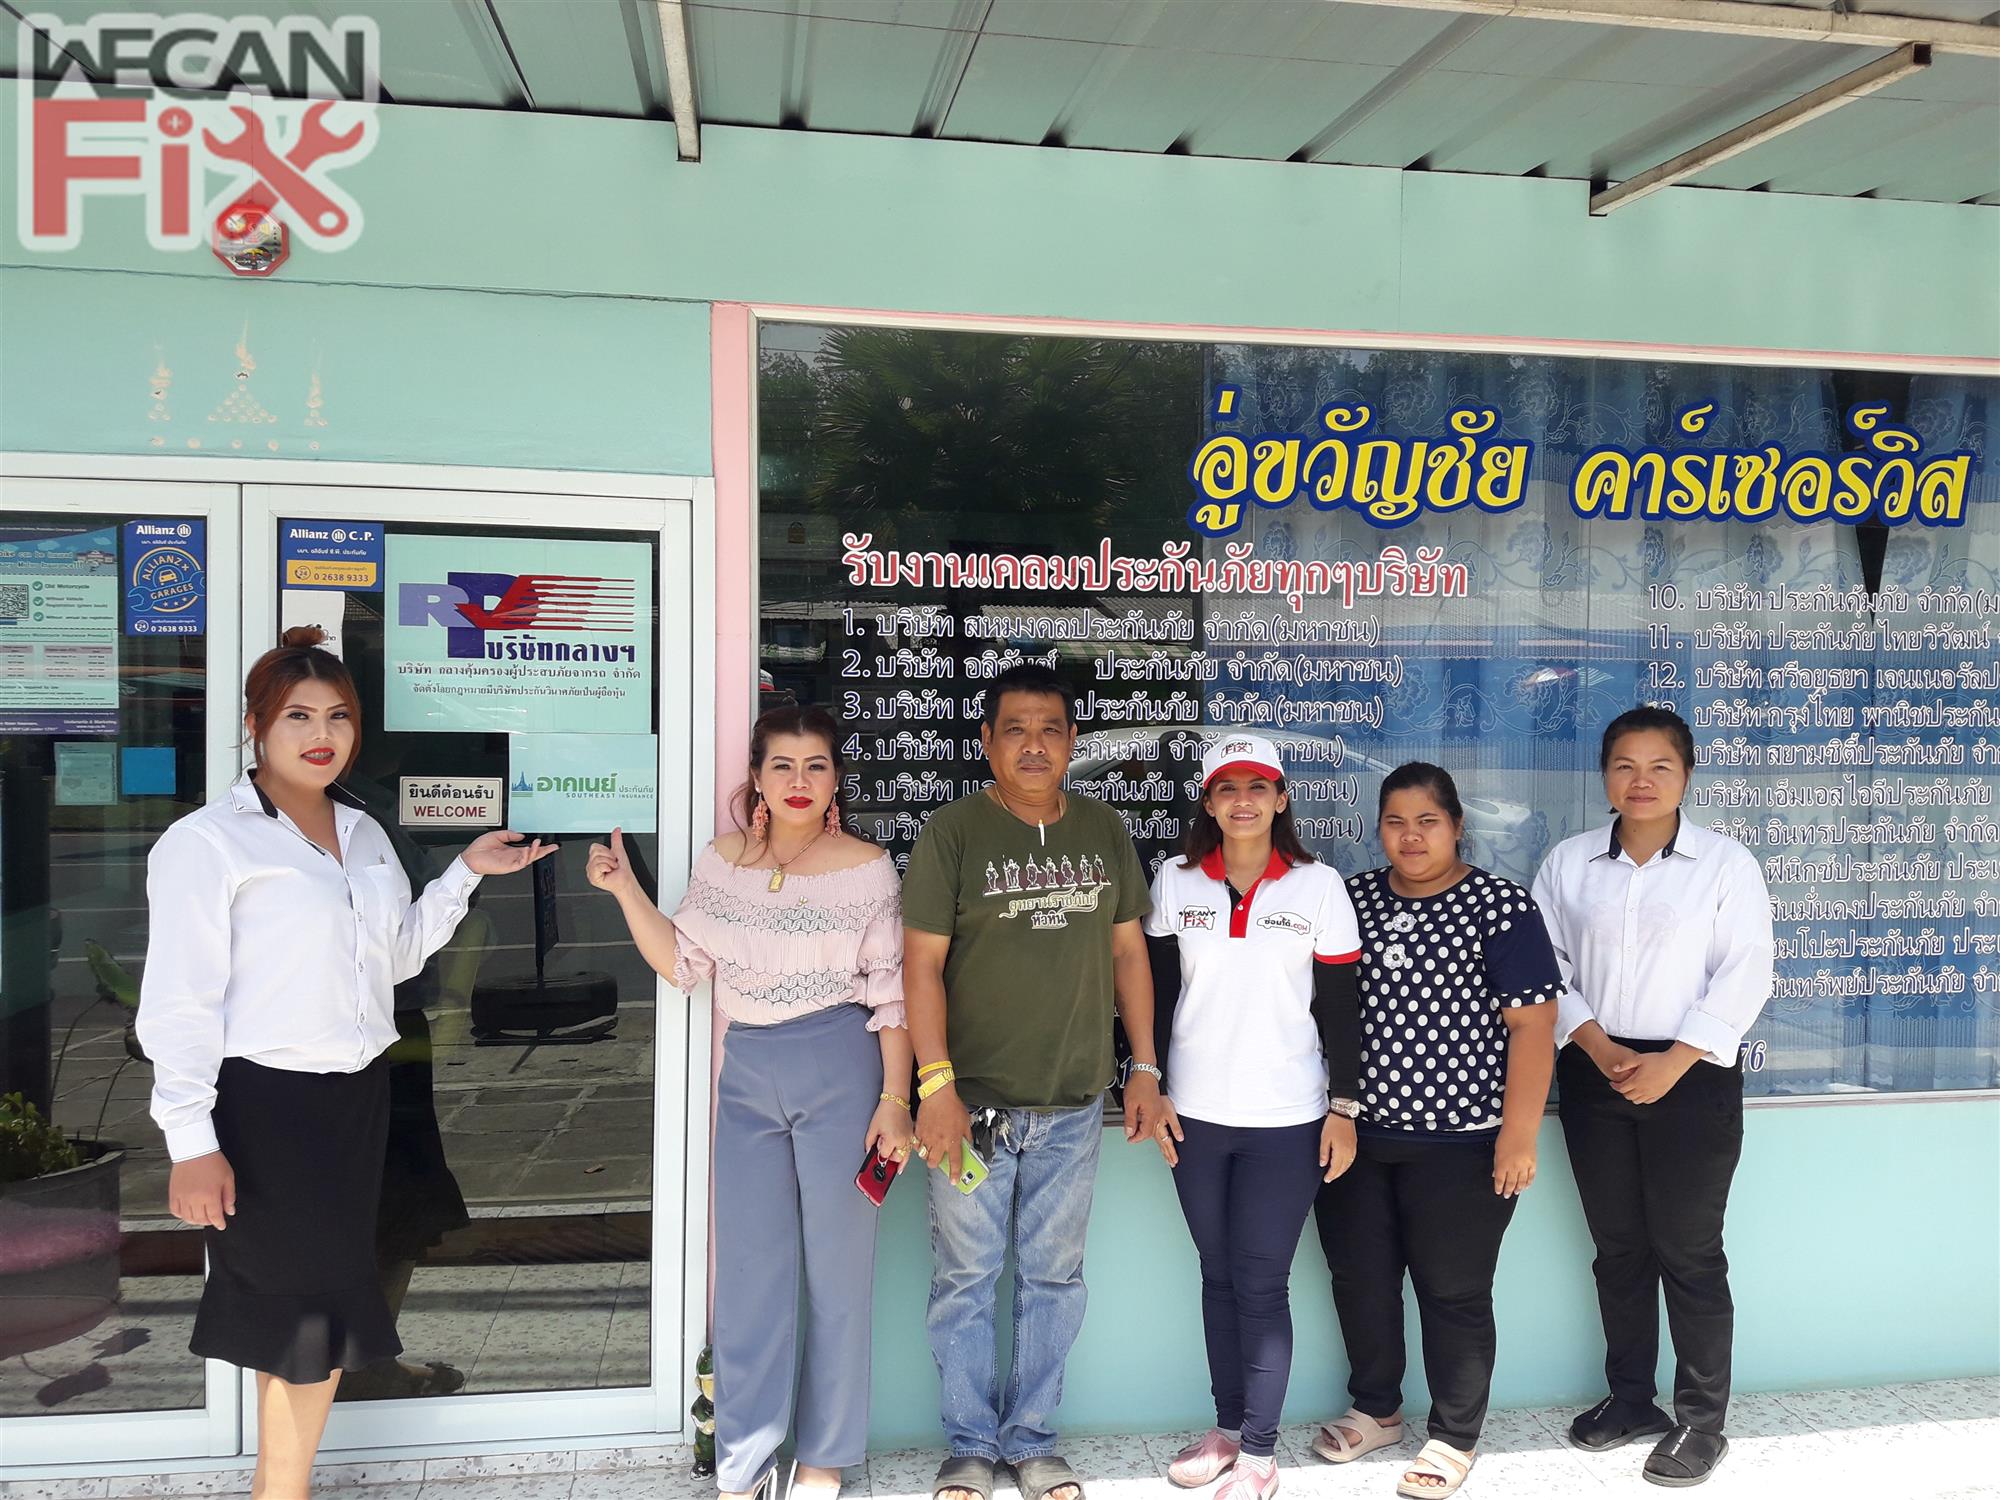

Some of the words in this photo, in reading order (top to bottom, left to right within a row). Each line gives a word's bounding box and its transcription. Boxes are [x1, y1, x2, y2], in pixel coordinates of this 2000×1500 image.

[1190, 386, 1532, 533] อู่ขวัญชัย
[1571, 400, 1974, 523] คาร์เซอร์วิส
[136, 525, 175, 535] Allianz
[289, 528, 329, 539] Allianz
[142, 555, 182, 581] ALLIANZ
[322, 573, 344, 581] 2638
[347, 574, 369, 582] 9333
[842, 532, 1468, 613] รับงานเคลมประกันภัยทุกๆบริษัท
[151, 583, 194, 600] GARAGES
[1648, 583, 1685, 611] 10.
[1695, 582, 1762, 612] บริษัท
[1768, 583, 1908, 616] ประกันคุ้มภัย
[842, 608, 865, 636] 1.
[876, 605, 954, 638] บริษัท
[963, 608, 1195, 640] สหมงคลประกันภัย
[1203, 612, 1380, 647] จำกัด(มหาชน)
[1648, 622, 1684, 650] 11.
[1695, 622, 1762, 650] บริษัท
[486, 634, 635, 663] บริษัทกลางฯ
[398, 663, 432, 675] บริษัท
[439, 664, 606, 680] กลางคุ้มครองผู้ประสบภัยจากรถ
[612, 667, 641, 679] จำกัด
[841, 648, 871, 678] 2.
[876, 648, 954, 679] บริษัท
[1094, 649, 1218, 681] ประกันภัย
[1227, 651, 1404, 687] จำกัด(มหาชน)
[1648, 662, 1685, 688] 12.
[1695, 661, 1762, 690] บริษัท
[1768, 661, 1869, 694] ศรีอยุธยา
[841, 691, 871, 720] 3.
[876, 689, 954, 721] บริษัท
[1208, 693, 1384, 727] จำกัด(มหาชน)
[1695, 699, 1762, 728] บริษัท
[1768, 695, 1855, 733] กรุงไทย
[841, 733, 872, 761] 4.
[876, 730, 954, 761] บริษัท
[1071, 730, 1160, 762] ะกันภัย
[1695, 737, 1762, 766] บริษัท
[1766, 733, 1964, 766] สยามซิตี้ประกันภัย
[409, 783, 494, 800] ยินดีต้อนรับ
[537, 773, 617, 793] อาคเนย์
[619, 784, 654, 793] ประกันภัย
[844, 773, 871, 801] 5.
[876, 771, 954, 802] บริษัท
[1695, 779, 1762, 808] บริษัท
[413, 805, 486, 817] WELCOME
[1707, 817, 1761, 846] ริษัท
[1765, 816, 1936, 845] อินทรประกันภัย
[1765, 853, 1940, 883] ฟีนิกซ์ประกันภัย
